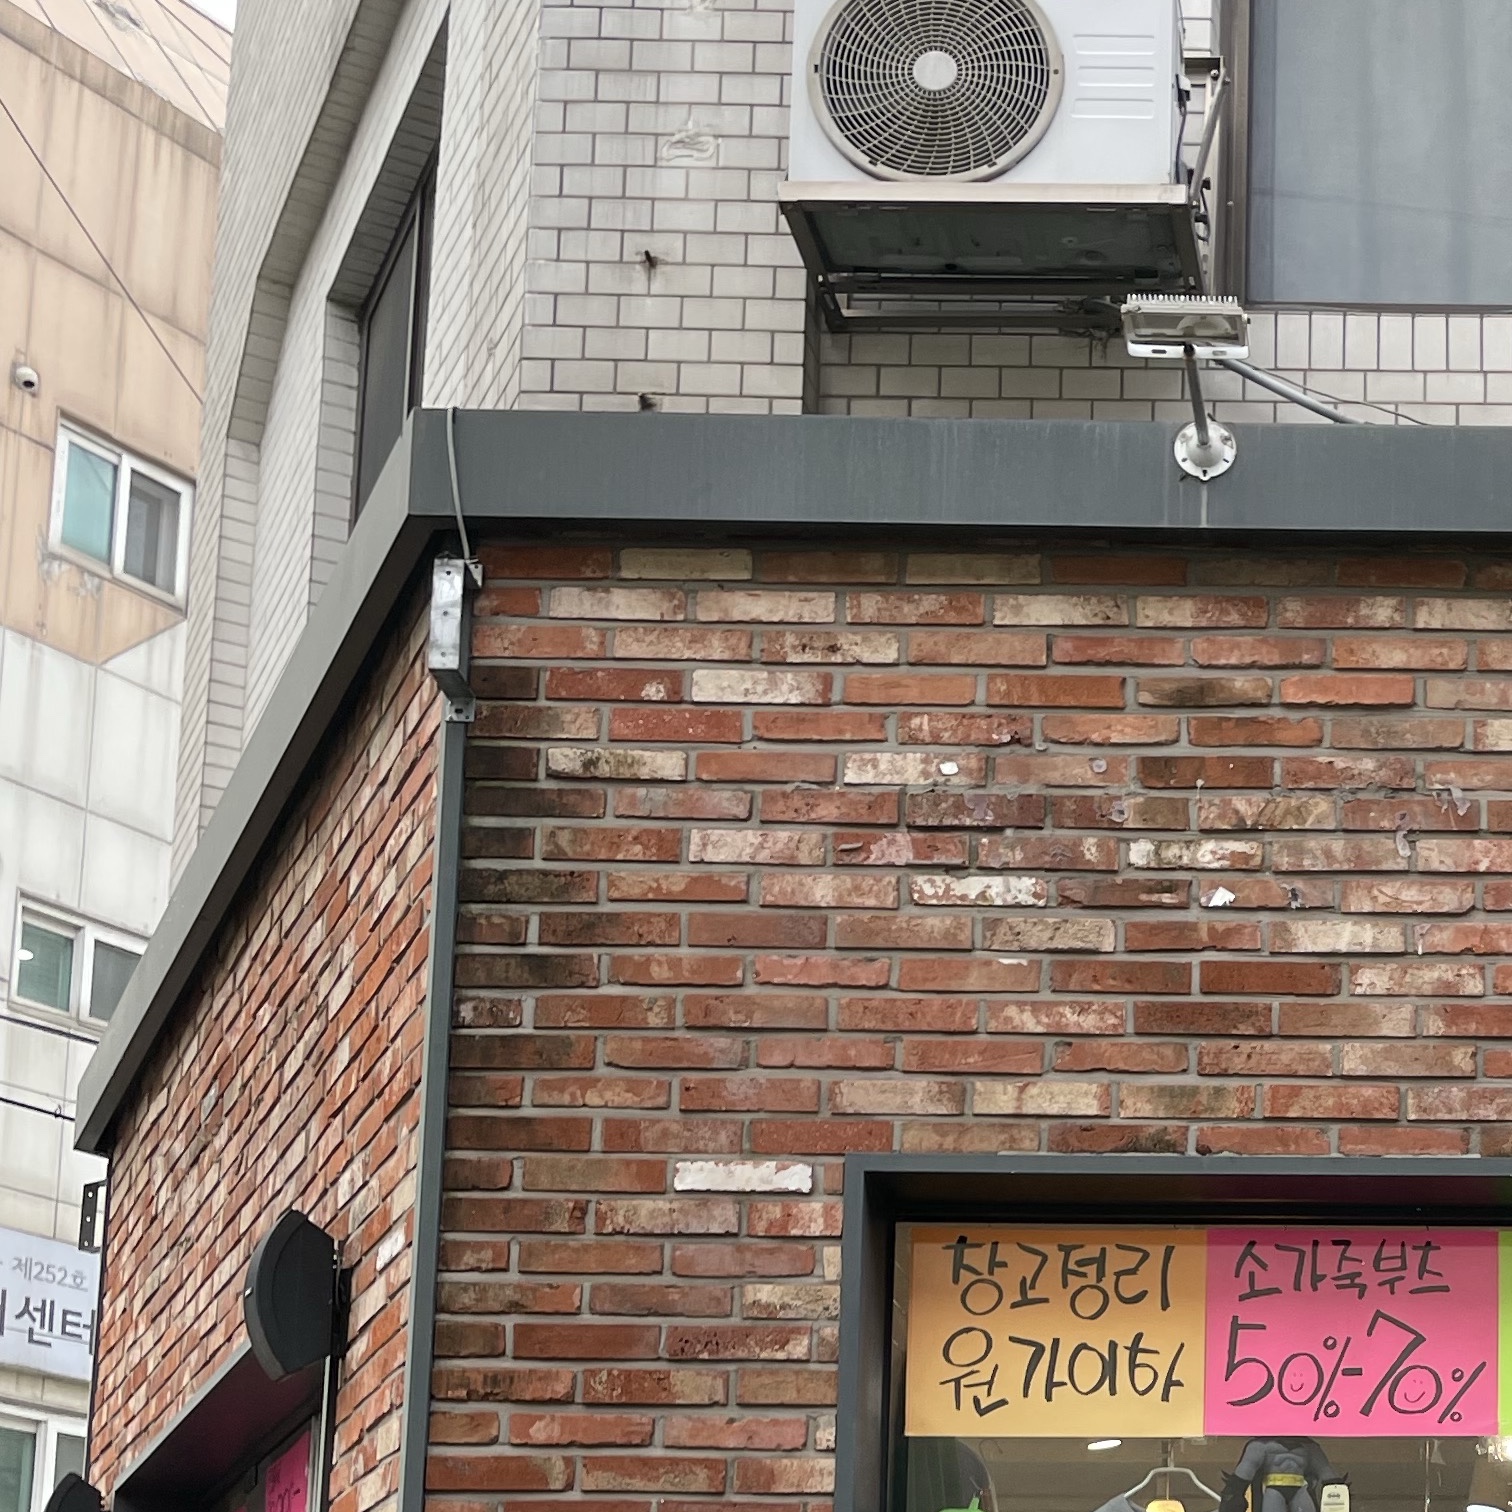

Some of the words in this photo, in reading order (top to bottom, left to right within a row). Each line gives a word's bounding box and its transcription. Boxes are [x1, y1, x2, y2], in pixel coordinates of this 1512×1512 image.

[12, 1257, 88, 1292] 제252호
[943, 1236, 1174, 1318] 창고정리
[1234, 1239, 1450, 1301] 소가죽부츠
[0, 1288, 96, 1356] 센터
[939, 1326, 1186, 1417] 원가이하
